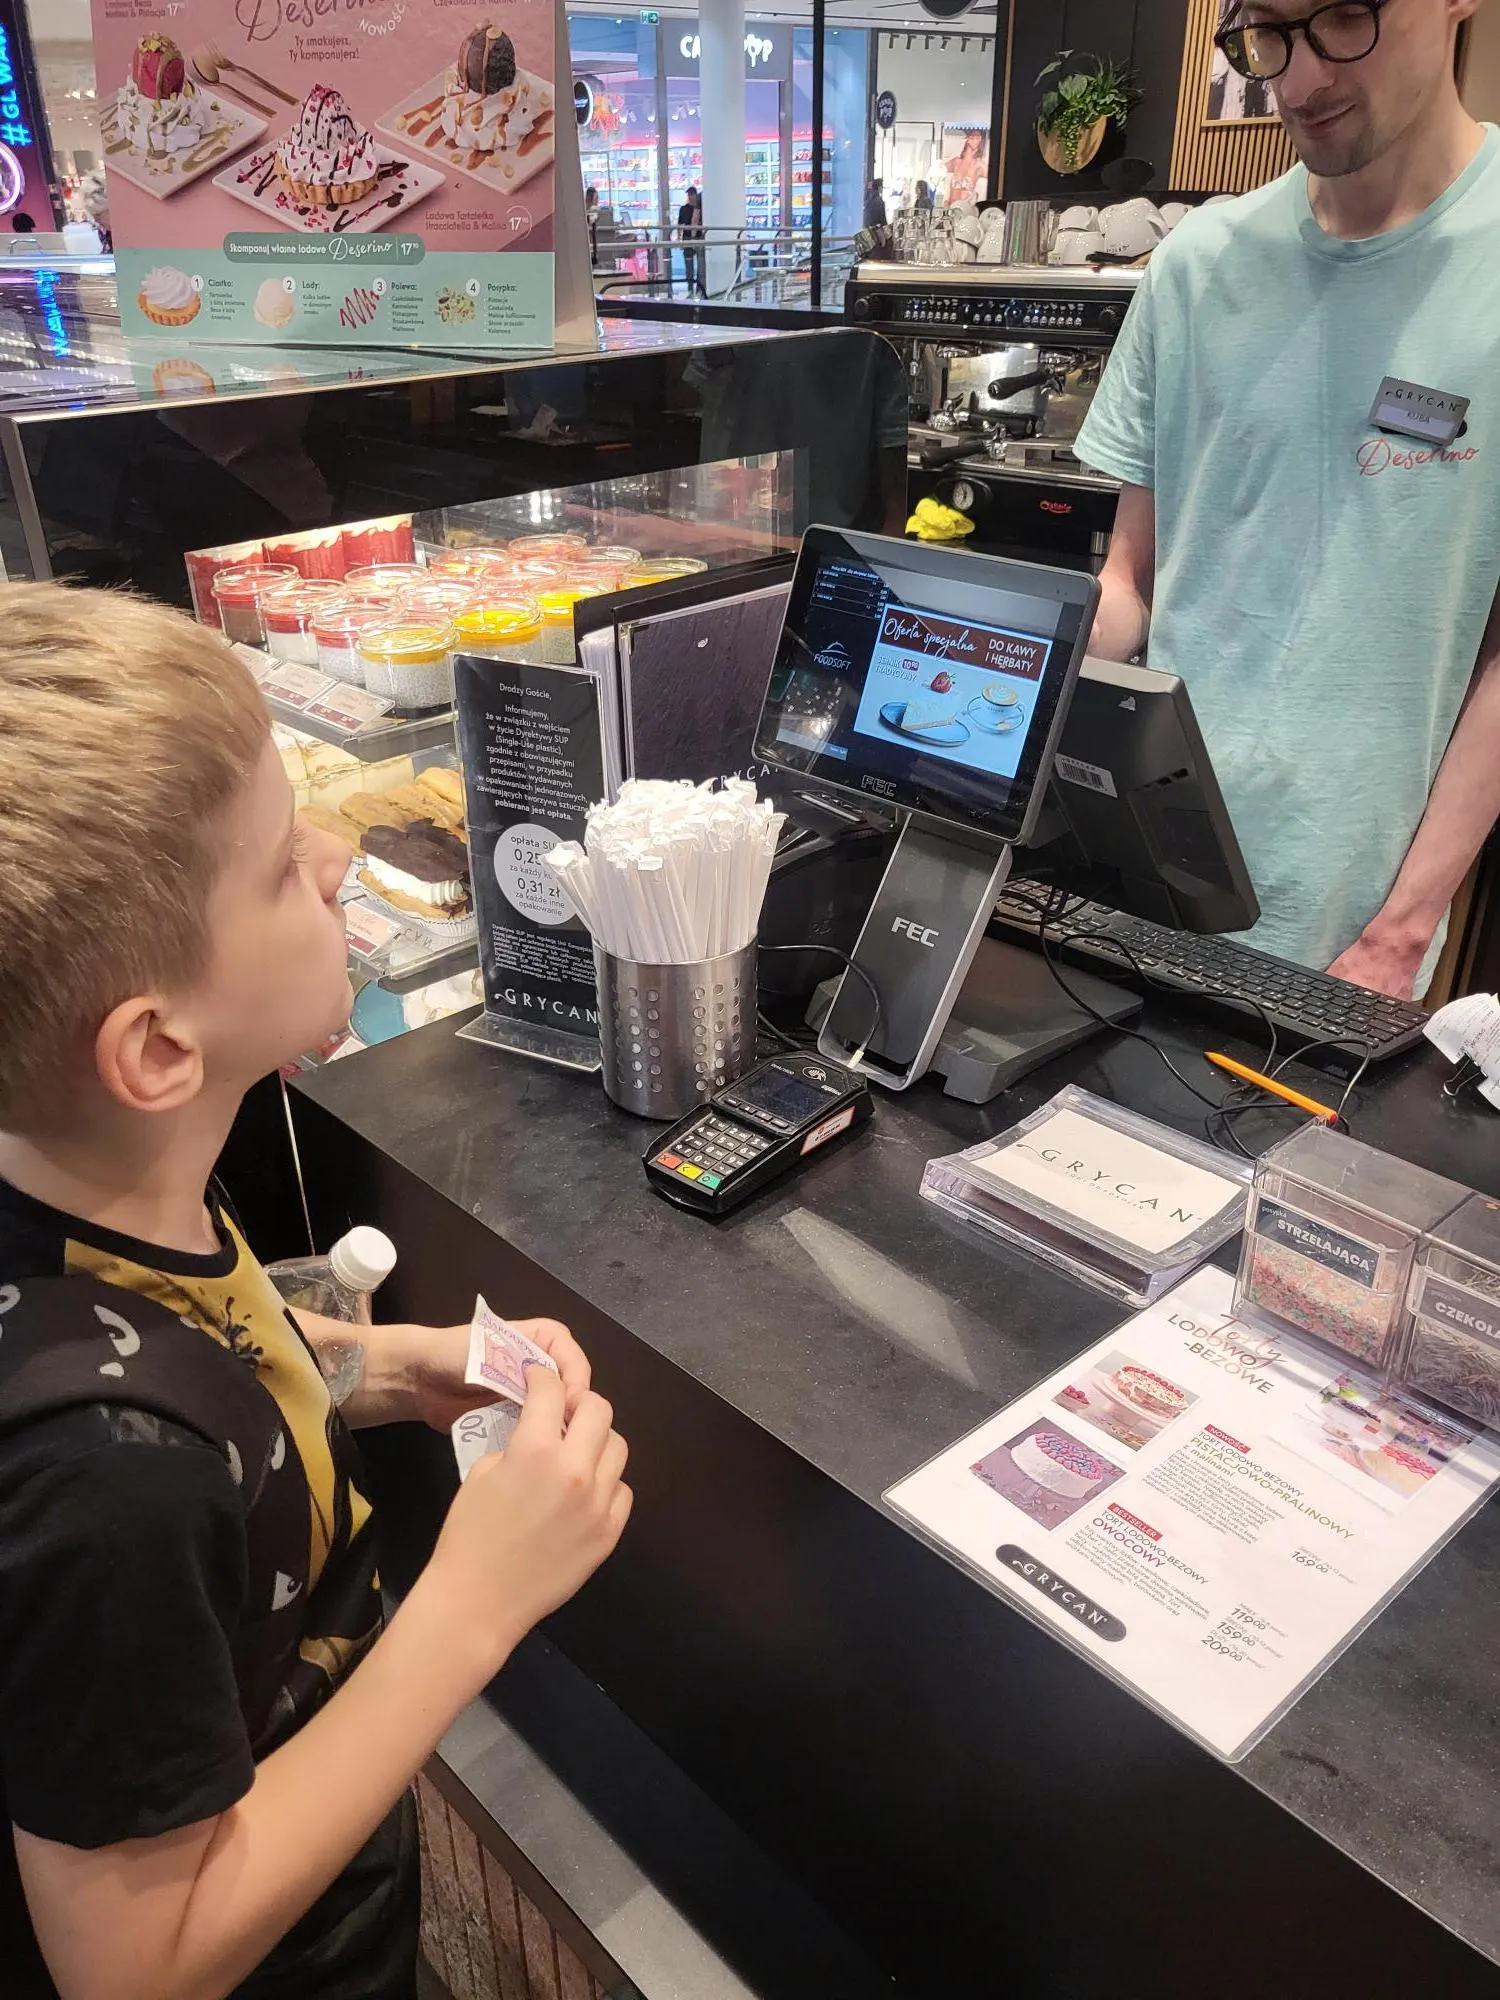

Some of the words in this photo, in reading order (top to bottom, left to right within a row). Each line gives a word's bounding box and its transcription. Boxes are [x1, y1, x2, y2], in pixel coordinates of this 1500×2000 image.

[295, 36, 303, 48] Ty
[289, 50, 298, 62] Ty
[230, 243, 270, 255] Skomponuj
[328, 237, 393, 261] Deserino
[1385, 389, 1456, 412] GRYCAN
[1357, 438, 1480, 476] Deserino
[884, 616, 923, 641] Oferta
[923, 628, 978, 660] specjalna
[988, 638, 1004, 652] DO
[1006, 642, 1038, 659] KAWY
[813, 653, 852, 671] FOODSOFT
[992, 655, 1034, 672] HERBATY
[500, 683, 524, 696] Drodzy
[526, 687, 552, 701] Goście,
[485, 712, 494, 720] że
[504, 715, 531, 727] związku
[538, 722, 570, 734] wejściem
[505, 704, 549, 720] Informujemy,
[496, 724, 514, 736] życie
[516, 729, 552, 744] Dyrektywy
[555, 736, 568, 745] SUP
[496, 735, 534, 749] (Single-Use
[536, 743, 563, 756] plastic),
[486, 745, 513, 757] zgodnie
[520, 750, 575, 768] obowiązującymi
[489, 756, 528, 769] przepisami,
[536, 765, 572, 778] przypadku
[486, 776, 533, 790] opakowaniach
[534, 785, 588, 803] jednorazowych,
[491, 768, 527, 780] produktów
[528, 773, 572, 788] wydawanych
[861, 774, 897, 798] FEC
[476, 784, 523, 801] zawierających
[524, 795, 557, 808] tworzywa
[559, 803, 589, 813] sztuczn
[495, 800, 530, 812] pobierana
[531, 806, 546, 816] jest
[511, 835, 540, 848] opłata
[517, 878, 543, 894] 0,31
[549, 886, 560, 898] zł
[518, 900, 562, 916] opakowanie
[526, 893, 547, 905] każde
[550, 900, 564, 908] inne
[891, 916, 940, 948] FEC
[494, 988, 597, 1024] GRYCAN
[1016, 1143, 1194, 1223] GRYCAN
[1277, 1219, 1370, 1272] STRZELAJĄCA
[1167, 1313, 1257, 1365] LODOWO
[459, 1414, 487, 1443] 20
[1191, 1449, 1234, 1477] malinami
[1198, 1431, 1220, 1446] TORT
[1221, 1443, 1304, 1497] LODOWO-BEZOWY
[1191, 1437, 1355, 1539] PISTACJOWO-PRALINOWY
[1113, 1506, 1157, 1538] BESTSELLER
[1092, 1518, 1166, 1568] OWOCOWY
[1101, 1510, 1124, 1527] TORT
[1124, 1526, 1208, 1585] LODOWO-BEZOWY
[1012, 1560, 1102, 1625] GRYCAN
